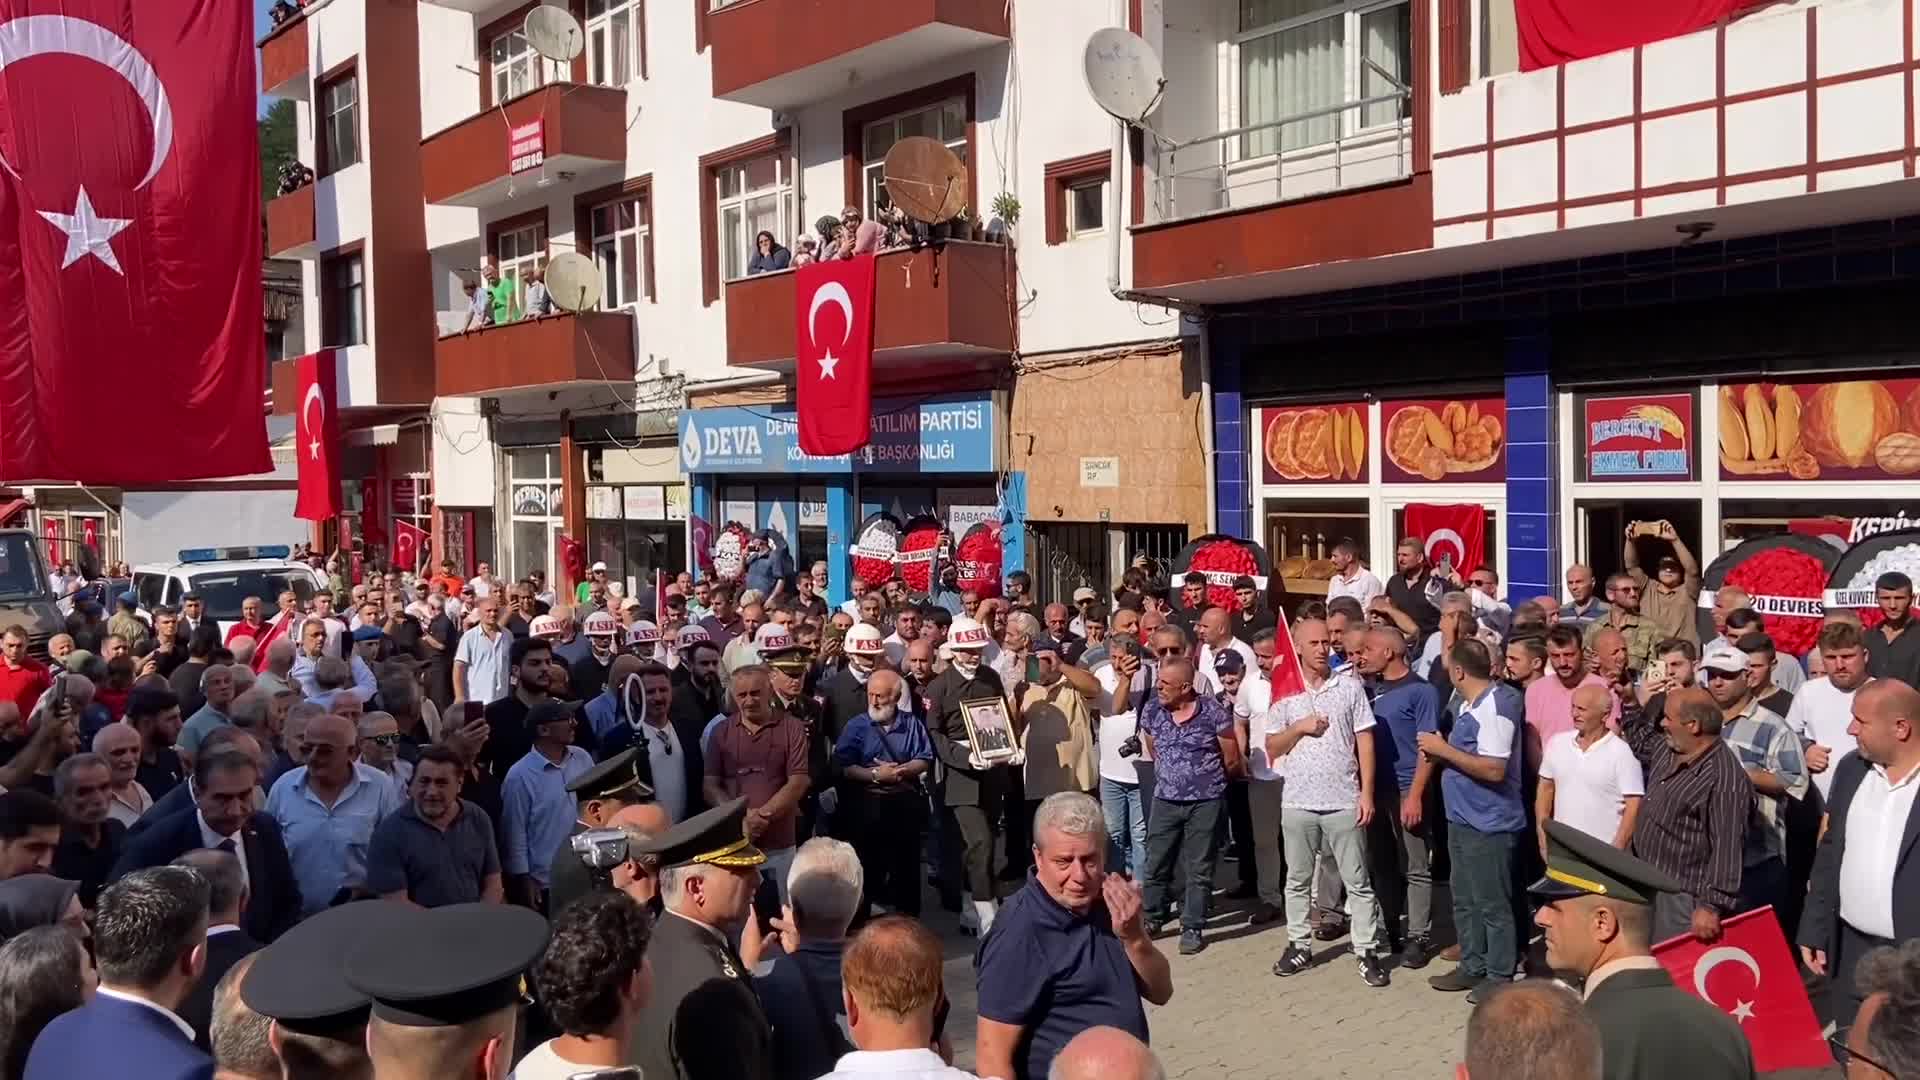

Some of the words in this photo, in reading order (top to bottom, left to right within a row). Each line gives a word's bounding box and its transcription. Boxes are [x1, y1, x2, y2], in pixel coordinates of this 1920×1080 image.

[766, 415, 798, 436] DEM
[920, 403, 982, 432] PARTİSİ
[1591, 417, 1663, 446] BEREKET
[704, 426, 762, 455] DEVA
[879, 440, 955, 464] BAŞKANLIĞI
[1592, 450, 1640, 471] EKMEK
